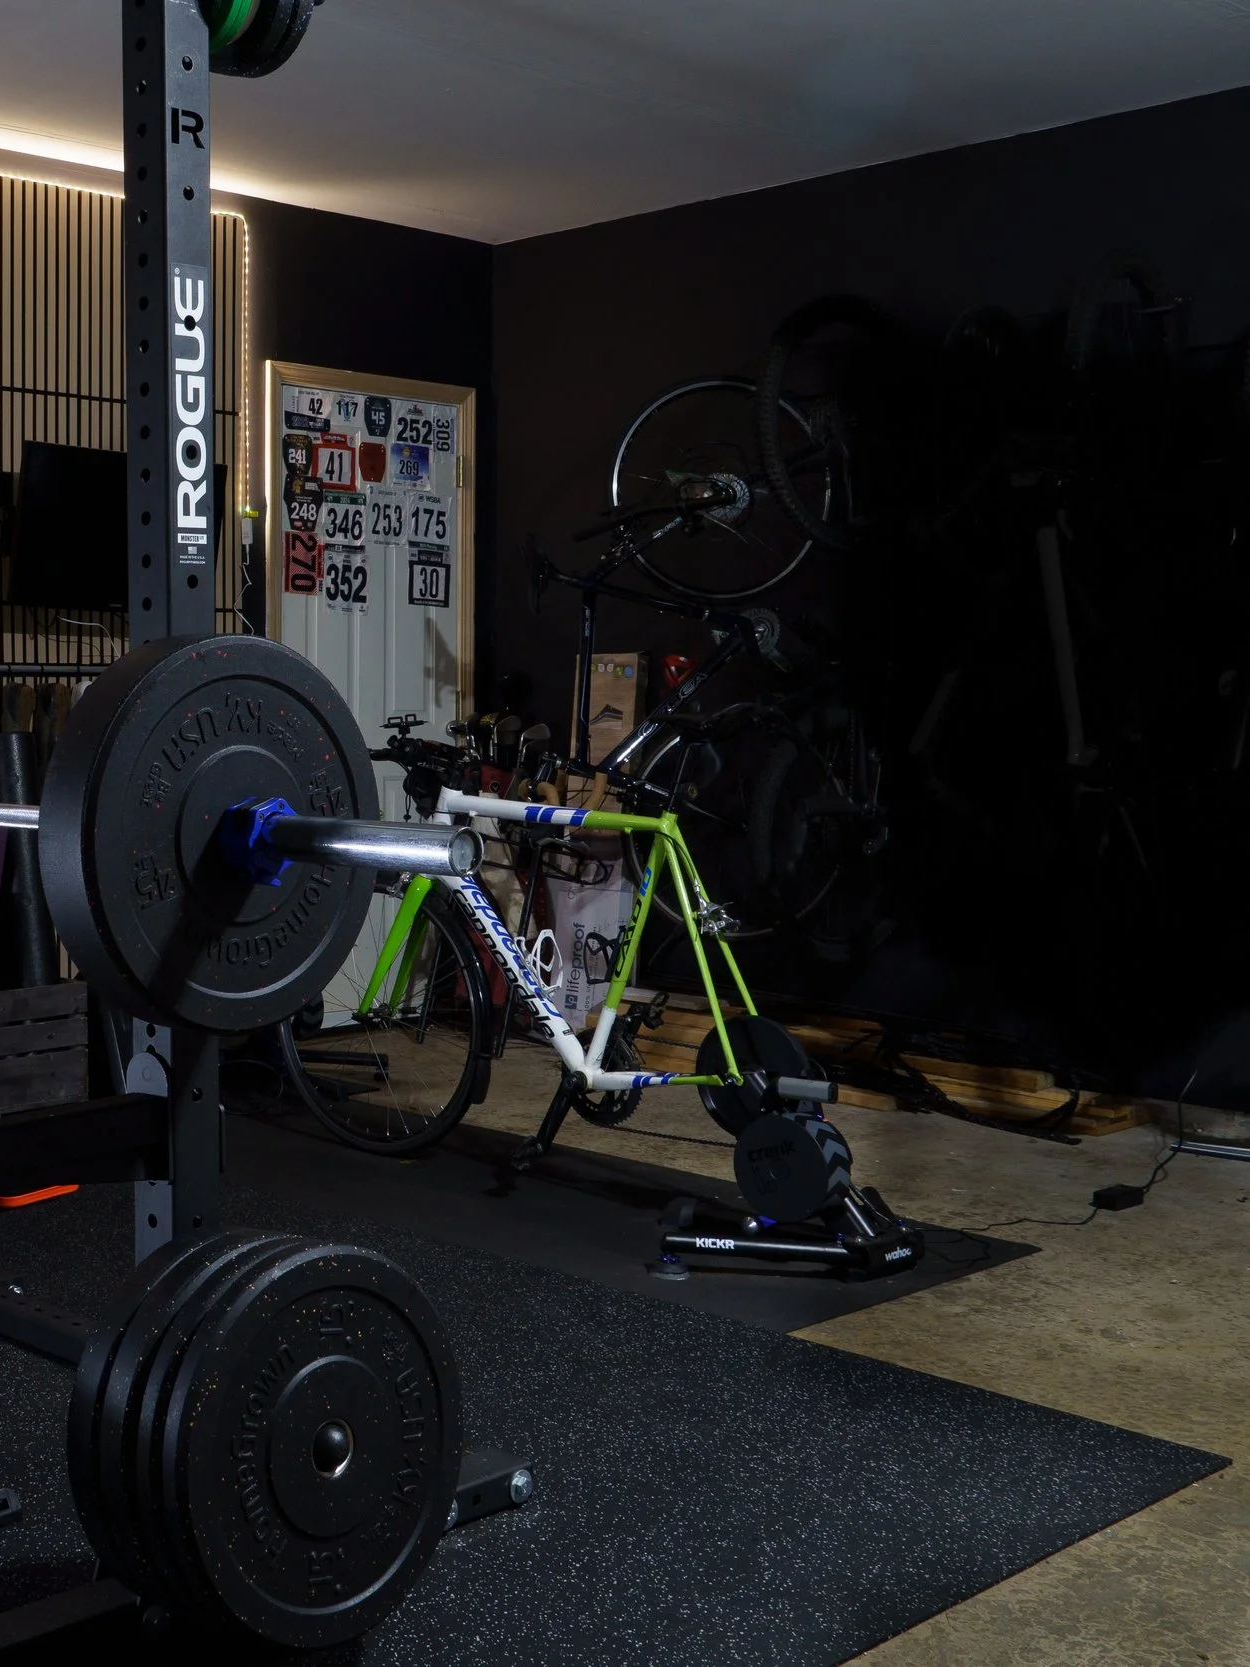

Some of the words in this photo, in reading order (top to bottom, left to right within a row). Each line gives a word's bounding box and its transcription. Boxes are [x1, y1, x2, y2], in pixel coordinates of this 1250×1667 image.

[174, 277, 207, 544] ROGUE
[309, 398, 323, 415] 42
[336, 399, 358, 417] 117
[371, 411, 385, 425] 45
[397, 417, 432, 445] 252
[436, 418, 450, 452] 309
[288, 448, 306, 464] 241
[325, 451, 343, 482] 41
[399, 459, 419, 476] 269
[290, 502, 317, 520] 248
[325, 508, 363, 541] 346
[372, 503, 402, 537] 253
[411, 506, 446, 539] 175
[291, 533, 318, 593] 270
[326, 563, 367, 603] 352
[419, 567, 439, 598] 30
[566, 922, 586, 993] lifeproof
[695, 1236, 735, 1250] KICKR
